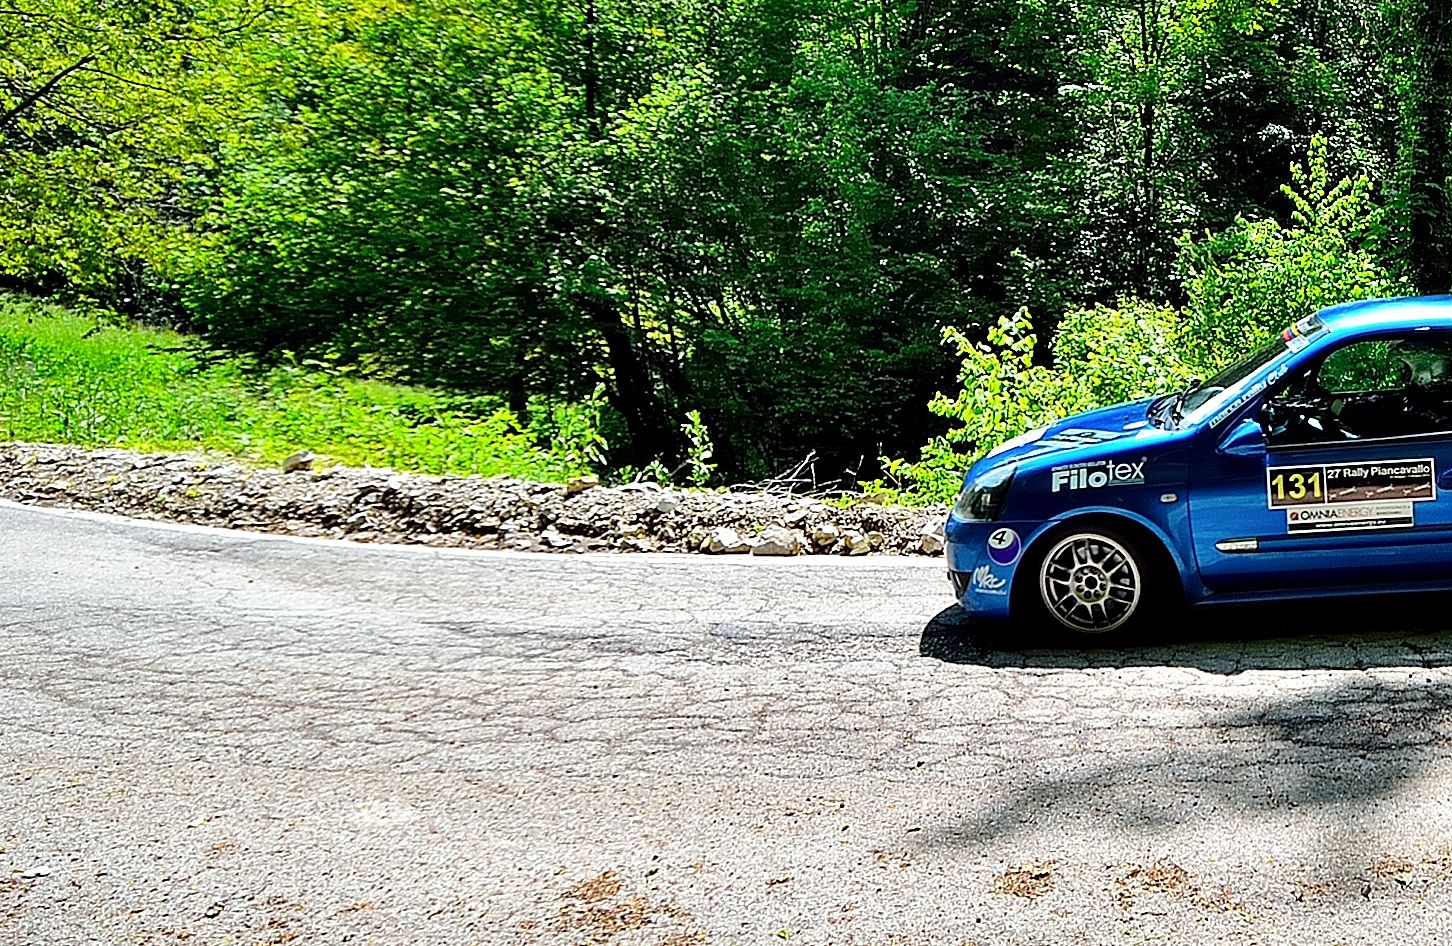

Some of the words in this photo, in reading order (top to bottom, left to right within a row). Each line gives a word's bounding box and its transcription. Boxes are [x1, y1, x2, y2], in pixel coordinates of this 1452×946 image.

[1052, 459, 1146, 493] Filotex
[1327, 468, 1341, 479] 27
[1343, 466, 1369, 479] Rally
[1371, 463, 1431, 477] Piancavallo
[1271, 472, 1322, 500] 131
[992, 530, 1007, 545] 4
